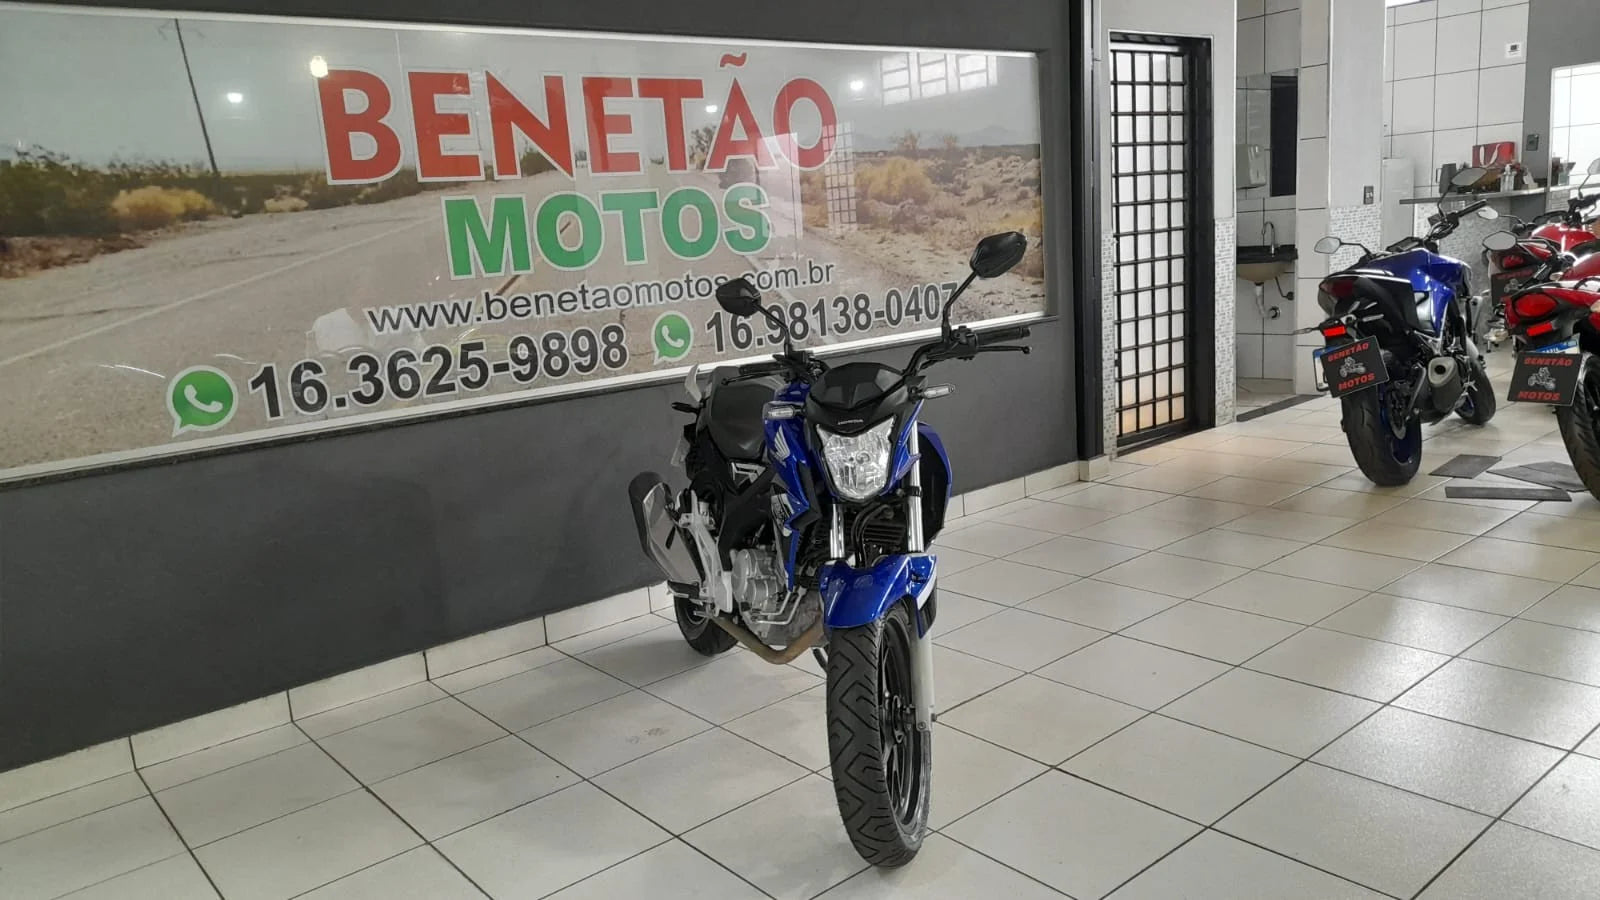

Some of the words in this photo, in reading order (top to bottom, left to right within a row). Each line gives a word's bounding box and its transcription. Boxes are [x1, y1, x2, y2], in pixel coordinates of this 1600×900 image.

[316, 52, 838, 183] BENETÃO
[442, 185, 773, 278] MOTOS
[367, 261, 835, 333] www.benetaomotoom.br
[706, 282, 958, 352] 16.98138-0407
[250, 325, 628, 418] 16.3625-9898
[1337, 372, 1376, 391] MOTOS
[1517, 390, 1561, 400] MOTOS
